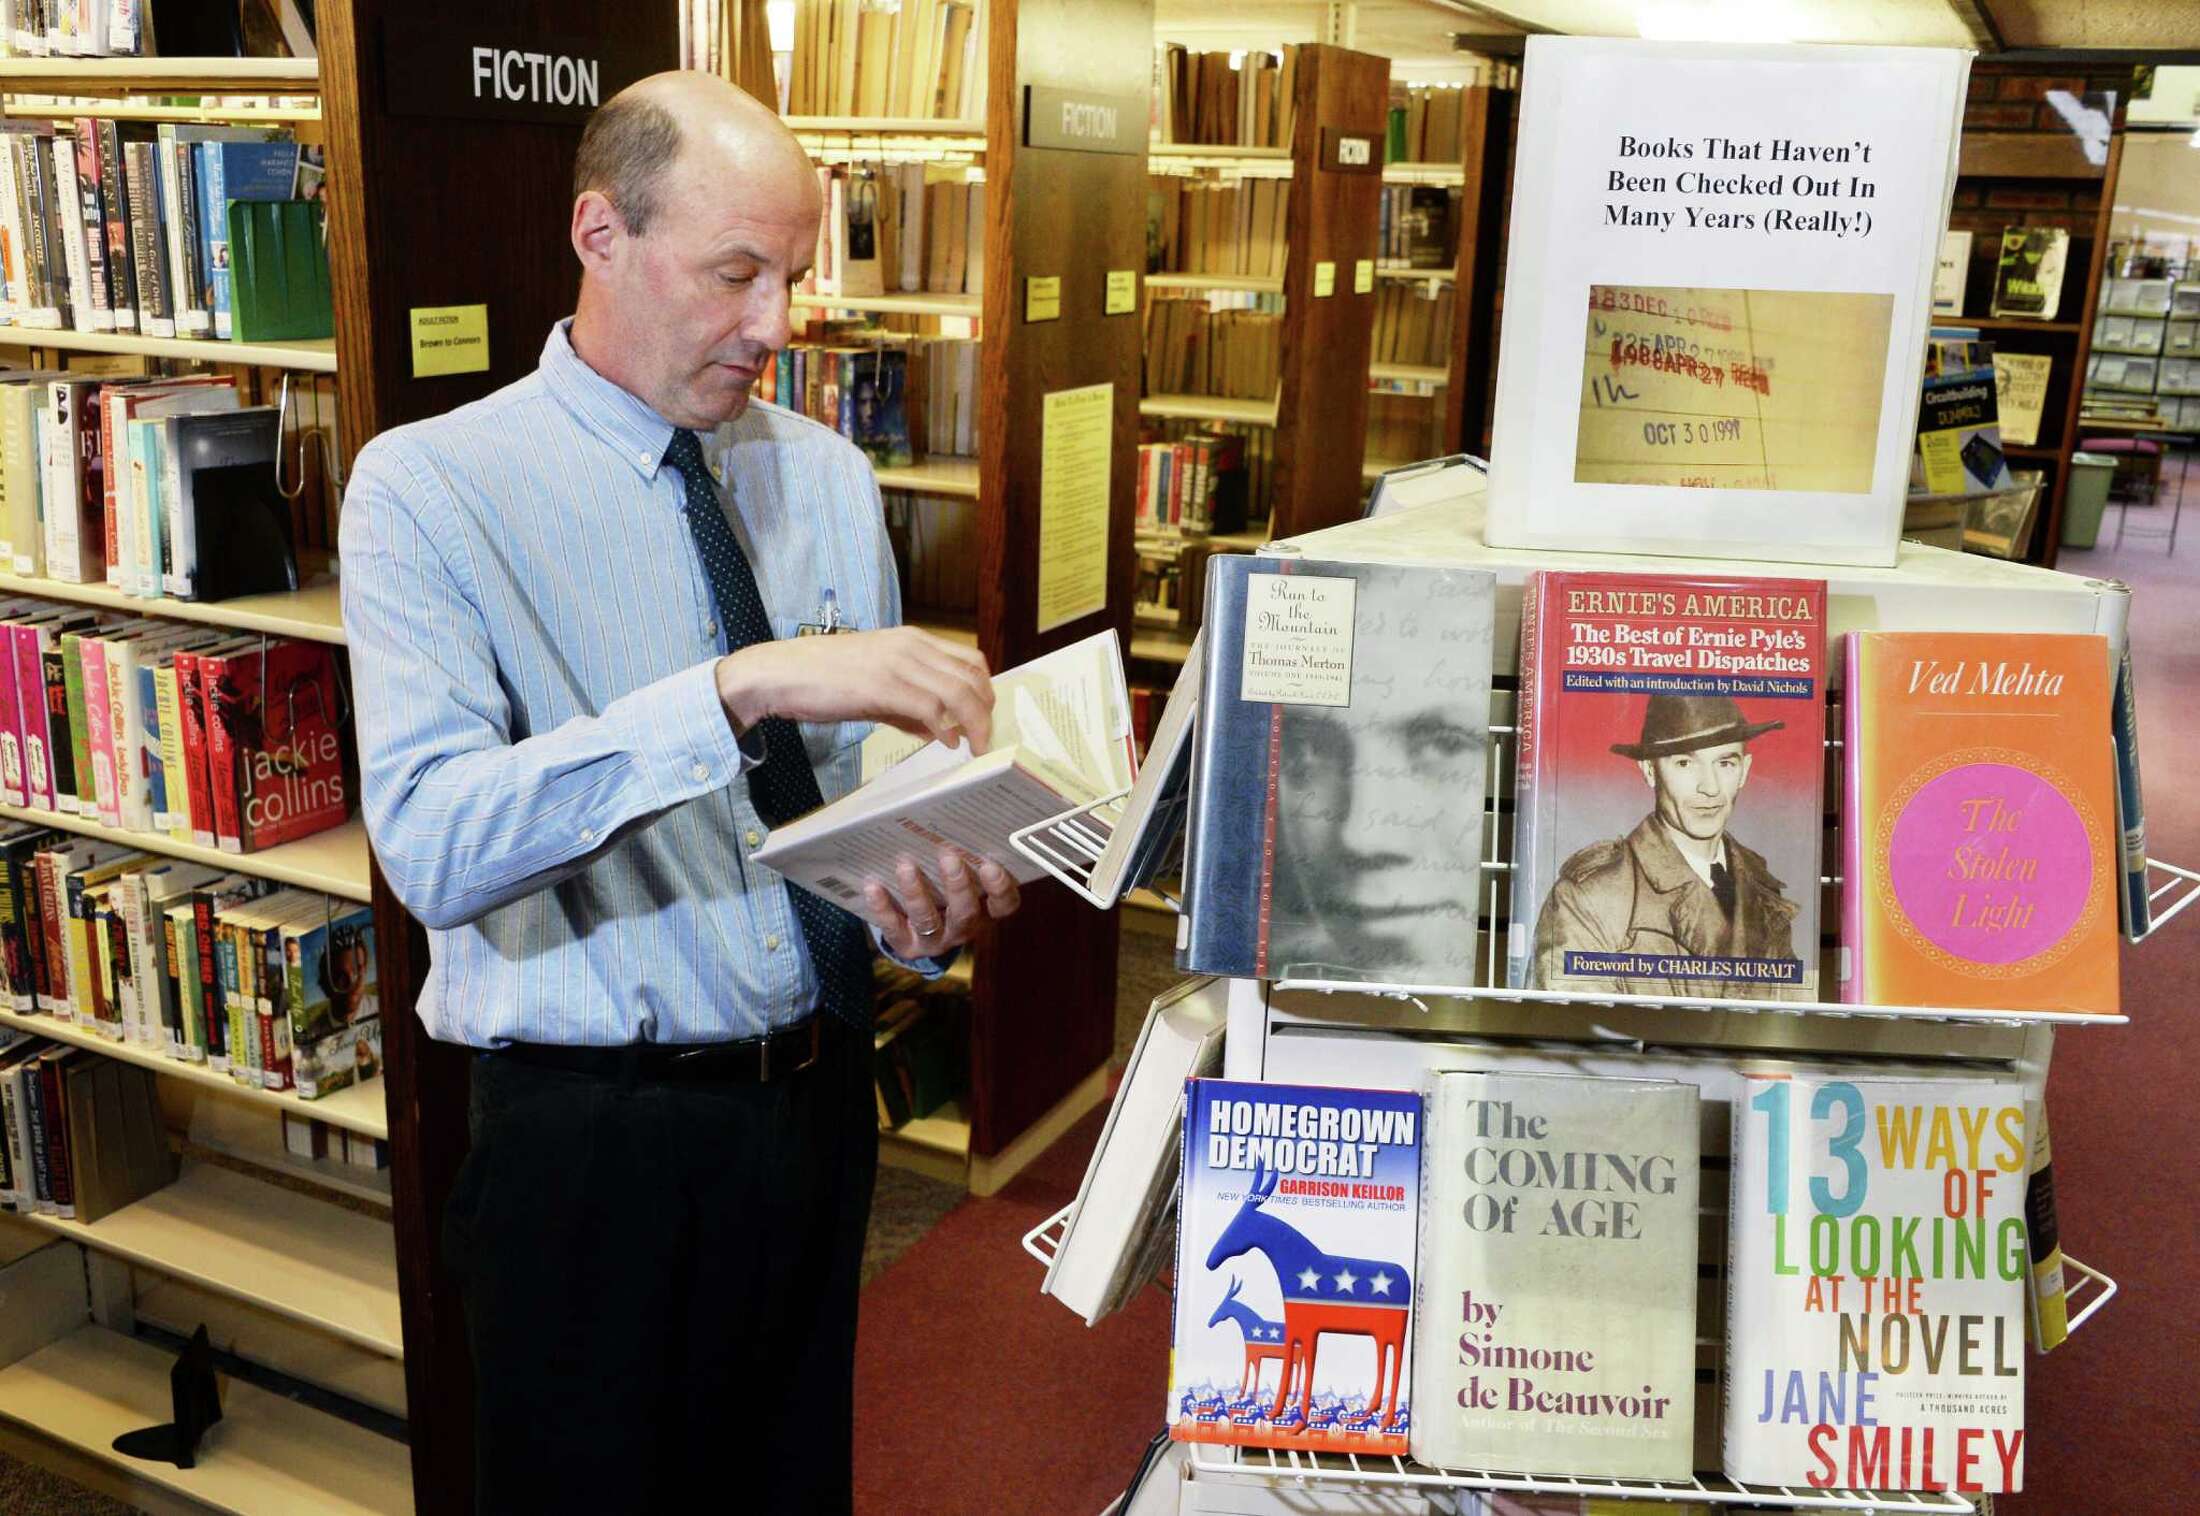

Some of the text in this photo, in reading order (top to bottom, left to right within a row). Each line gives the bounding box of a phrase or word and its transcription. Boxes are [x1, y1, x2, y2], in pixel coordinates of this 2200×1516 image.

[473, 46, 599, 107] FICTION
[1062, 102, 1117, 139] FICTION
[1619, 135, 1873, 163] Books That Haven't
[1607, 170, 1876, 199] Been Checked Out In
[1604, 204, 1873, 237] Many Years (Really!)
[87, 228, 103, 261] Miami
[420, 339, 443, 349] Brown
[445, 338, 452, 346] to
[1643, 421, 1677, 446] OCT
[1271, 580, 1326, 602] Run to
[1567, 590, 1814, 621] ERNIE'S AMERICA
[1258, 611, 1338, 635] Mountain
[1288, 602, 1313, 620] the
[1571, 623, 1807, 651] The Best of Ernie Pyle's
[1248, 650, 1345, 671] Thomas Merton
[1566, 646, 1812, 674] 1930s Travel Dispatches
[1906, 660, 2066, 697] Ved Mehta
[110, 663, 122, 698] Jackie
[1566, 674, 1809, 696] Edited with an introduction by David Nichols
[111, 701, 126, 741] Collins
[181, 669, 200, 747] jackie collins
[204, 673, 225, 753] jackie collins
[1521, 667, 1535, 753] AMERICA
[161, 722, 177, 769] COLLINS
[244, 731, 337, 797] jackie
[247, 775, 344, 827] collins
[1960, 799, 2024, 833] The
[1948, 847, 2040, 882] Stolen
[1950, 893, 2037, 934] Light
[1573, 955, 1797, 980] Foreword by CHARLES KURALT
[1209, 1098, 1415, 1146] HOMEGROWN
[1466, 1099, 1550, 1141] The
[1208, 1133, 1379, 1179] DEMOCRAT
[1752, 1081, 1868, 1219] 13
[1876, 1104, 2025, 1173] WAYS
[1463, 1146, 1678, 1195] COMING
[1216, 1190, 1406, 1212] NEW YORK TIMES BESTSELLING AUTHOR
[1279, 1179, 1405, 1202] GARRISON KEILLOR
[1943, 1168, 1997, 1219] OF
[1462, 1192, 1643, 1240] Of AGE
[1774, 1213, 2025, 1281] LOOKING
[1462, 1289, 1504, 1329] by
[1804, 1276, 1924, 1315] AT THE
[1458, 1331, 1595, 1373] Simone
[1838, 1312, 2018, 1377] NOVEL
[1456, 1375, 1671, 1419] de Beauvoir
[1757, 1369, 1879, 1426] JANE
[1919, 1402, 2009, 1416] A THOUSAND ACRES
[1461, 1413, 1514, 1431] Author
[1519, 1416, 1537, 1432] of
[1546, 1418, 1575, 1435] The
[1579, 1420, 1638, 1438] Second
[1806, 1424, 2026, 1495] SMILEY
